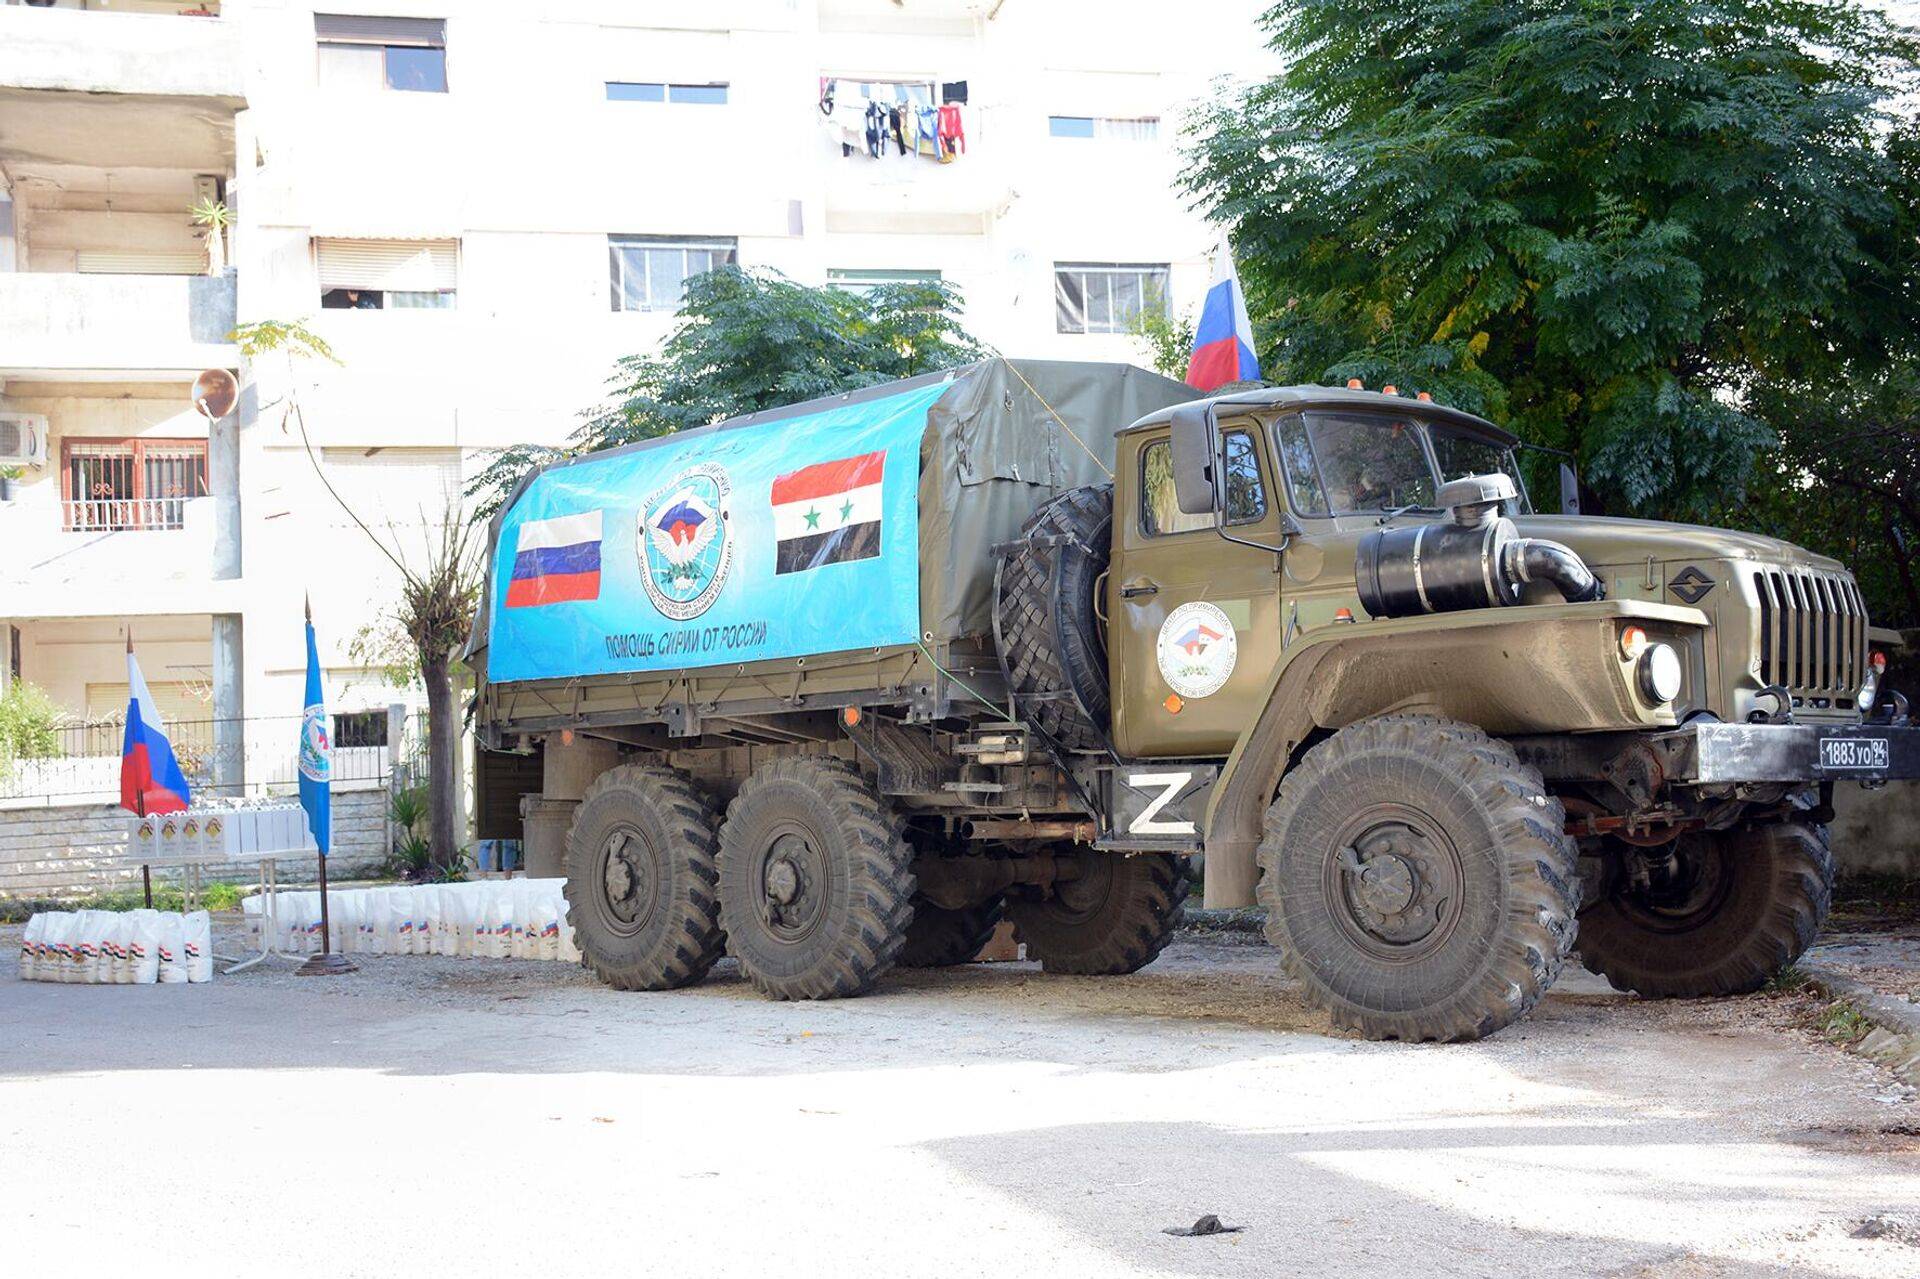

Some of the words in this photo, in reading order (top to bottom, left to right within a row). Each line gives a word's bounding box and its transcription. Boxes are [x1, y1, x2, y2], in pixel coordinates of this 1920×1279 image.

[605, 634, 655, 659] ПОМОЩЬ
[658, 629, 700, 656] СИРИИ
[703, 627, 720, 652] ОТ
[721, 621, 767, 650] РОССИИ
[1826, 742, 1855, 765] 1883
[1129, 772, 1196, 834] Z
